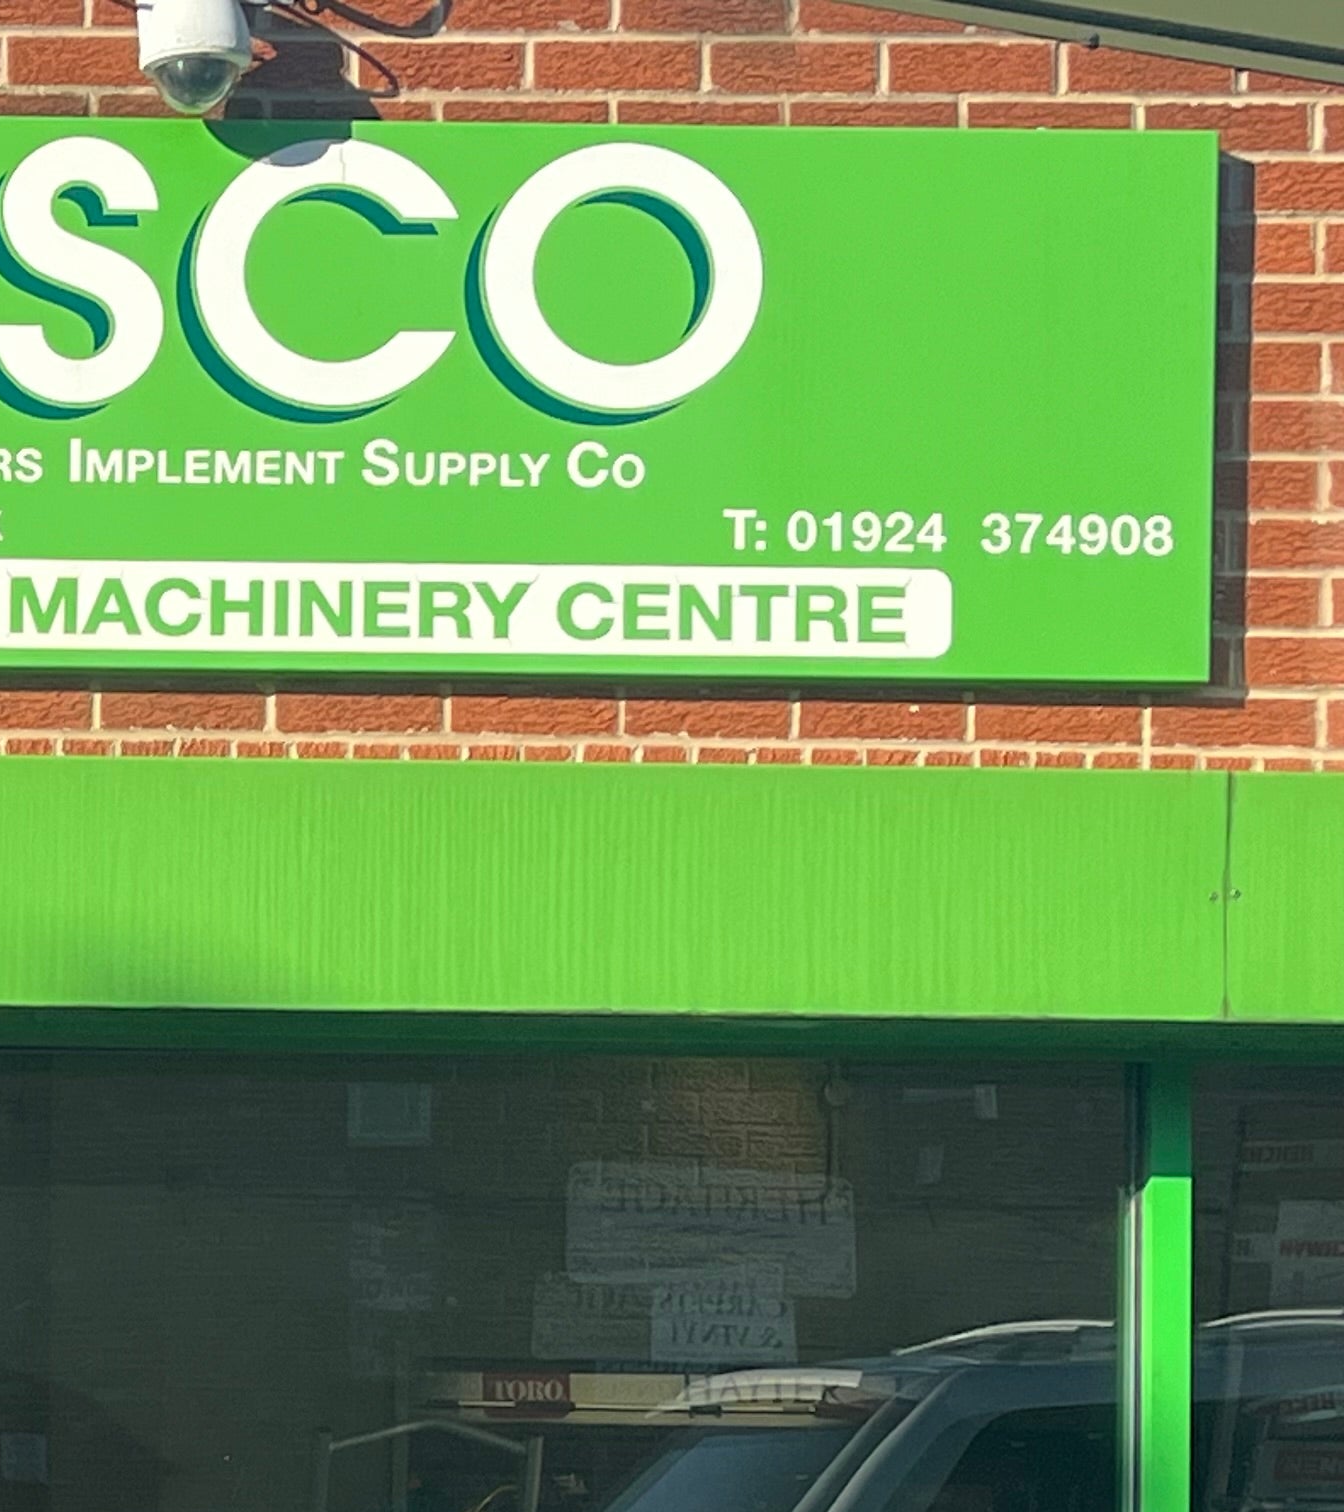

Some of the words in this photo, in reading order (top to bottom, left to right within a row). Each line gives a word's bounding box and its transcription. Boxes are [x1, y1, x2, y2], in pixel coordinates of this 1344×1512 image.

[722, 508, 767, 553] T:
[786, 508, 946, 556] 01924
[980, 510, 1174, 558] 374908
[9, 575, 536, 639] MACHINERY
[556, 581, 907, 644] CENTRE
